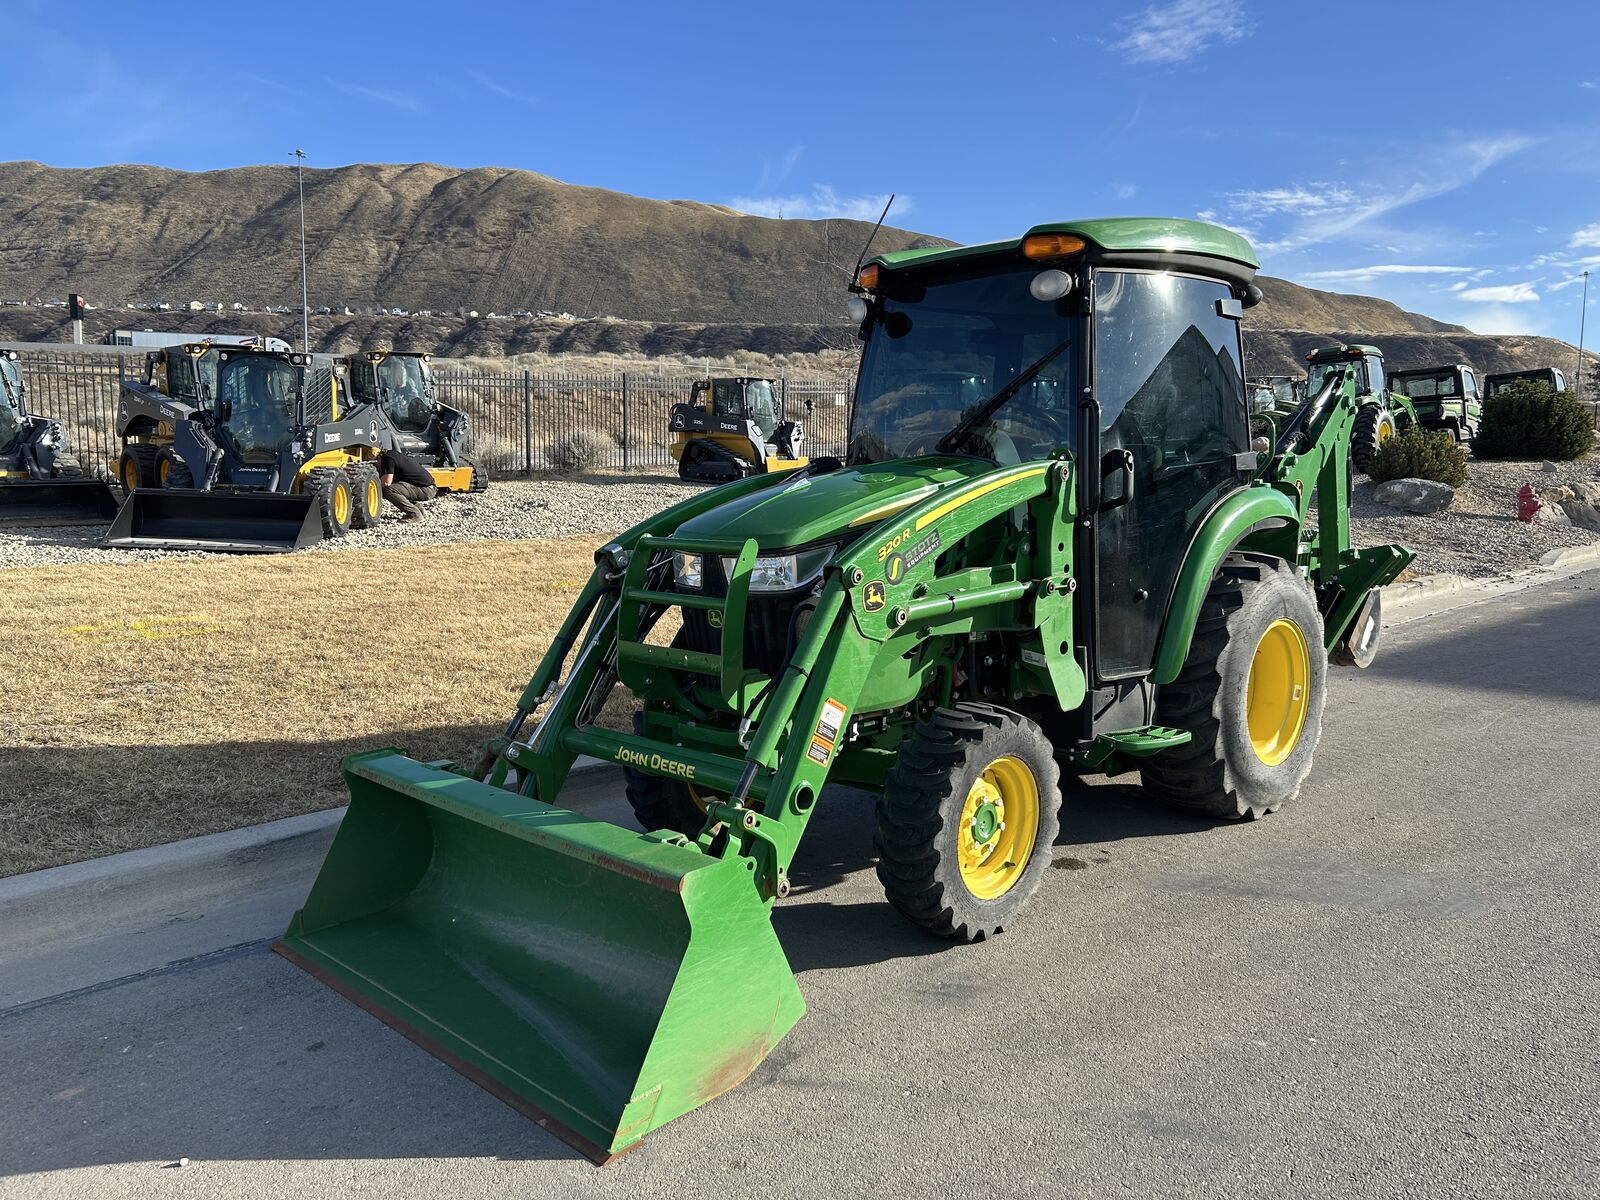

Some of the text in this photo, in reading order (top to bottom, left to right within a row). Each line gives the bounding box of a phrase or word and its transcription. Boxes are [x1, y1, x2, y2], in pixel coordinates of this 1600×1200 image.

[324, 432, 341, 443] DEERE
[720, 422, 738, 431] DEERE
[905, 532, 939, 562] STOTZ
[907, 540, 940, 568] EQUIPMENT
[614, 745, 696, 779] JOHN DEERE
